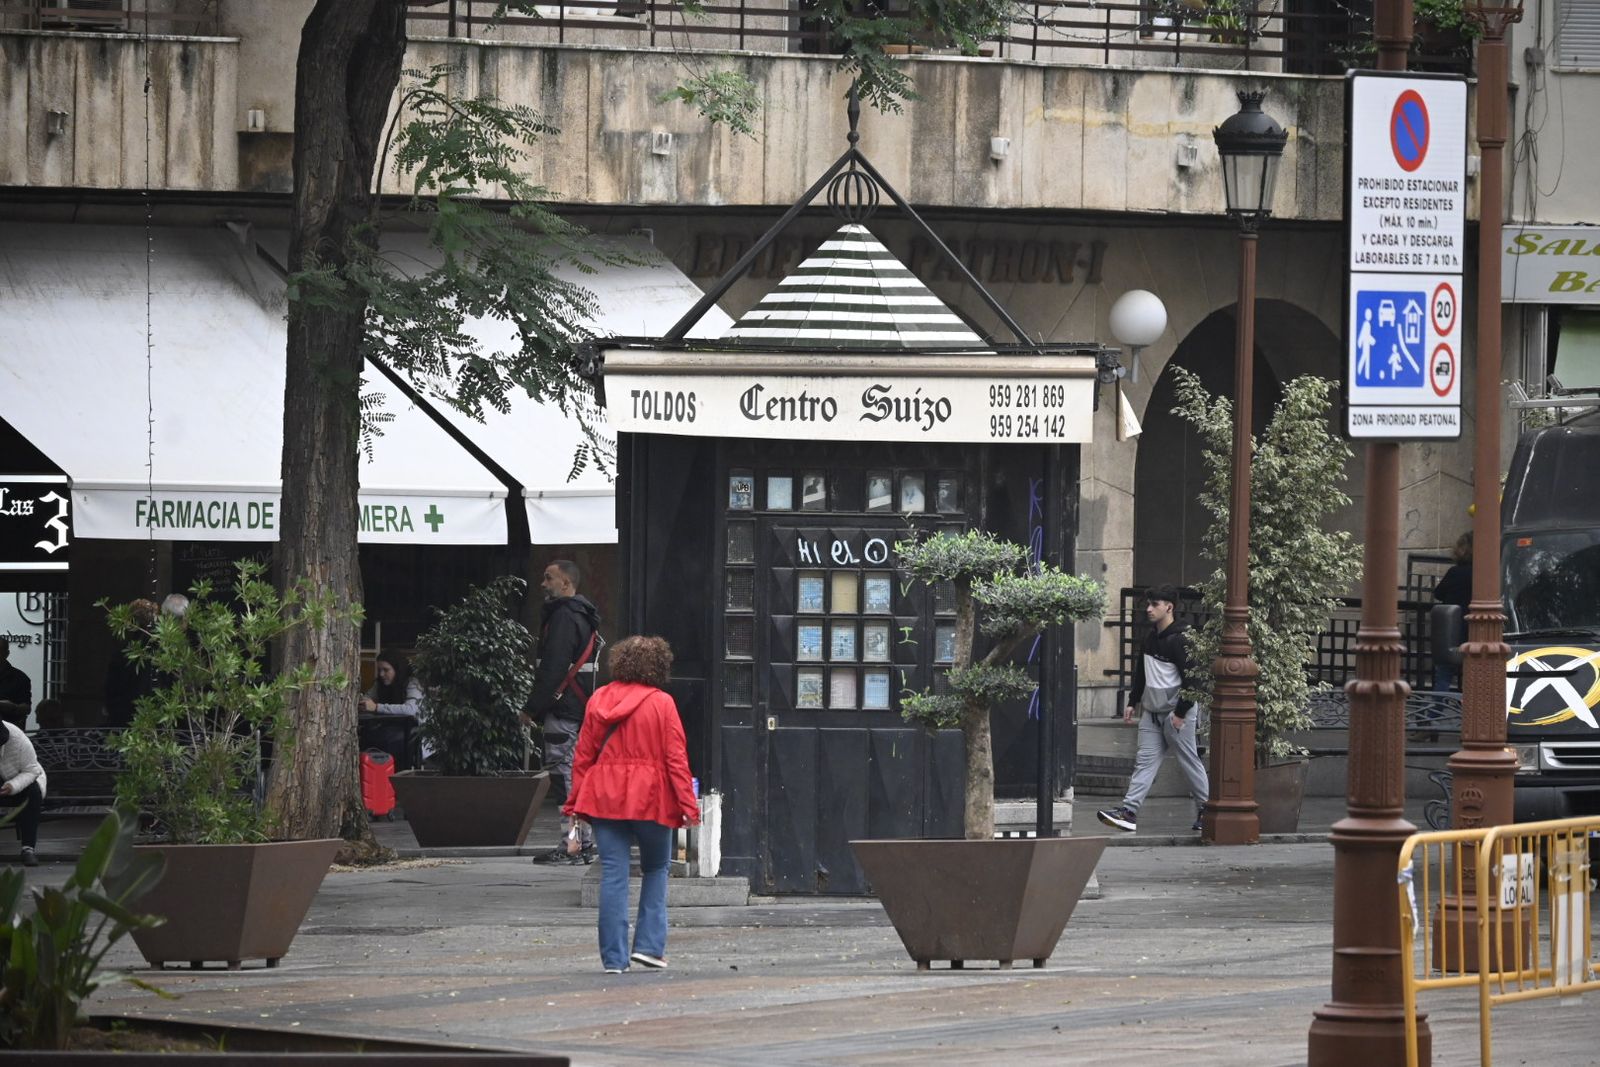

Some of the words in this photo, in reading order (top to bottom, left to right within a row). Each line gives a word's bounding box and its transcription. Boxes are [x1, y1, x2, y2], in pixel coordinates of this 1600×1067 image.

[1358, 178, 1404, 191] PROHIBIDO
[1407, 179, 1458, 192] ESTACIONAR
[1363, 196, 1400, 209] EXCEPTO
[1403, 198, 1453, 211] RESIDENTES
[1379, 213, 1403, 228] (MÁX.
[1406, 215, 1416, 228] 10
[1418, 215, 1438, 230] min.)
[1362, 234, 1367, 245] Y
[1370, 234, 1399, 246] CARGA
[1402, 235, 1408, 246] Y
[1410, 235, 1453, 247] DESCARGA
[1355, 252, 1409, 264] LABORABLES
[1412, 253, 1423, 265] DE
[1425, 254, 1430, 265] 7
[1433, 254, 1439, 265] A
[1441, 254, 1450, 265] 10
[1437, 302, 1451, 318] 20
[740, 383, 838, 422] Centro
[989, 384, 1011, 408] 959
[1016, 384, 1037, 408] 281
[1043, 384, 1064, 408] 869
[631, 389, 697, 423] TOLDOS
[990, 414, 1012, 438] 959
[1017, 414, 1039, 438] 254
[1044, 414, 1065, 438] 142
[1352, 413, 1373, 426] ZONA
[1376, 414, 1417, 427] PRIORIDAD
[1419, 415, 1457, 428] PEATONAL
[0, 487, 34, 516] Las
[34, 490, 69, 554] 3
[135, 500, 242, 529] FARMACIA
[247, 502, 274, 529] DE
[1504, 886, 1531, 904] LOAL
